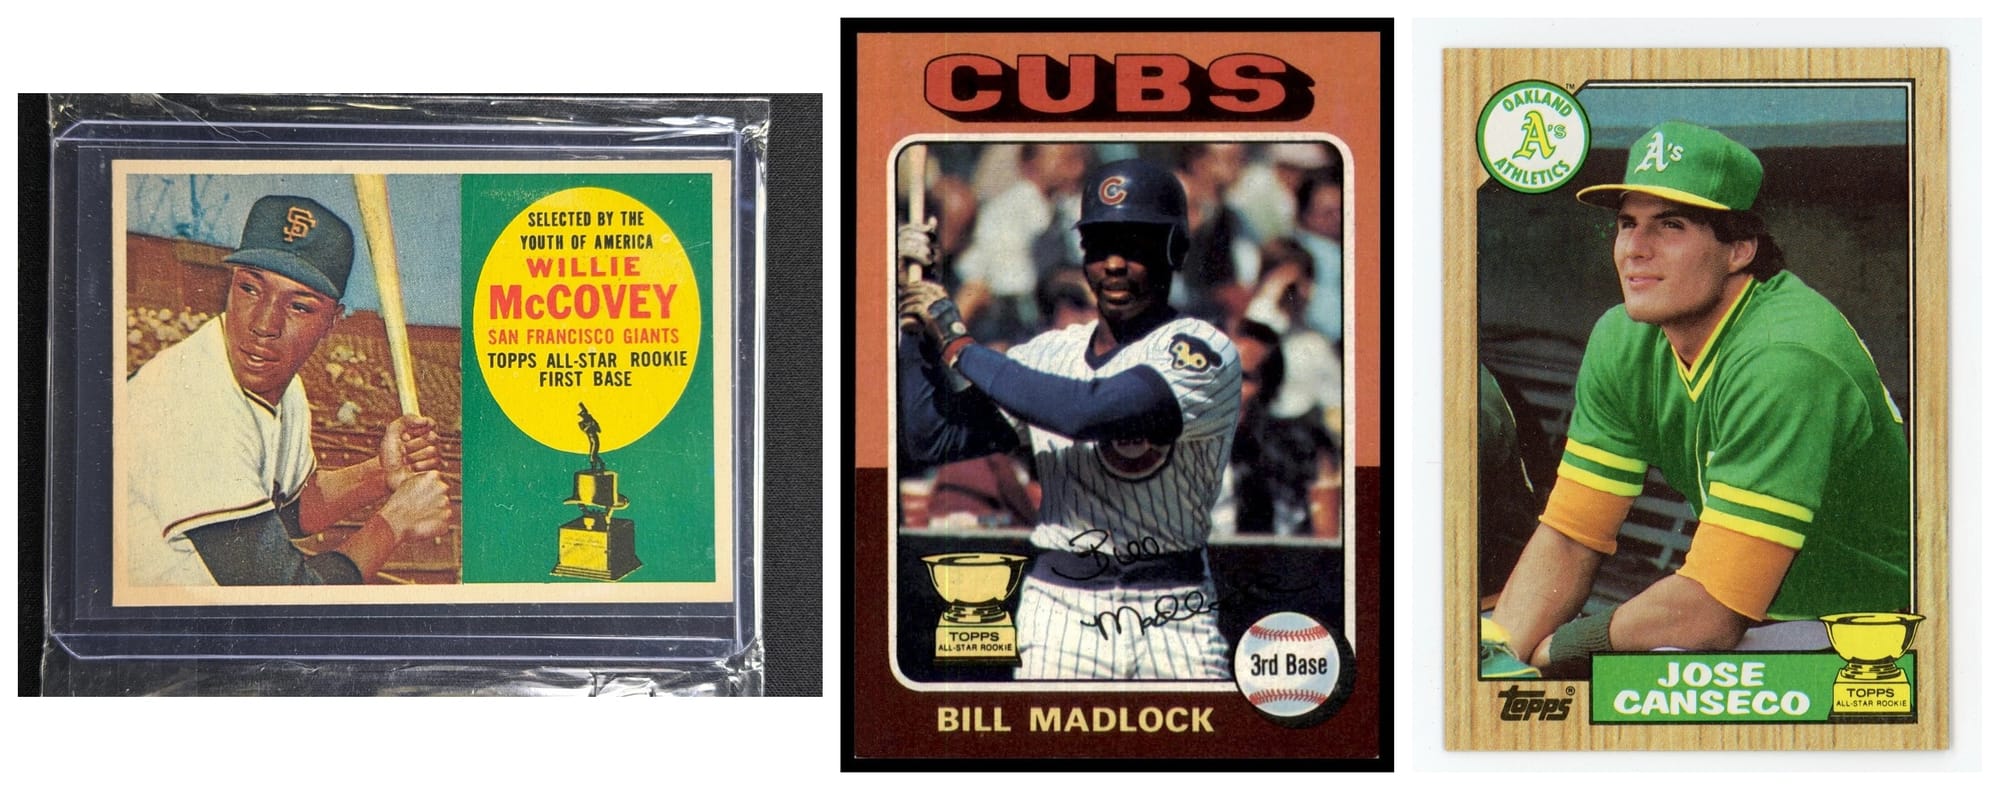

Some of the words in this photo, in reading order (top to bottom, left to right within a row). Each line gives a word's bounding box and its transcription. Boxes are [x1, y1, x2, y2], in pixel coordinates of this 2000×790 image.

[924, 53, 1295, 116] CUBS
[1502, 89, 1573, 118] OAKLAND
[1494, 156, 1571, 186] ATHLETICS
[1100, 175, 1128, 206] C
[528, 211, 591, 227] SELECTED
[599, 211, 613, 227] BY
[621, 211, 645, 226] THE
[520, 234, 564, 250] YOUTH
[571, 234, 587, 250] OF
[594, 234, 653, 249] AMERICA
[526, 256, 641, 278] WILLIE
[489, 284, 678, 320] McCOVEY
[488, 329, 519, 345] SAN
[526, 328, 614, 345] FRANCISCO
[623, 328, 679, 344] GIANTS
[488, 352, 537, 369] TOPPS
[546, 352, 617, 369] ALL-STAR
[630, 351, 688, 367] ROOKIE
[539, 371, 583, 387] FIRST
[593, 371, 632, 387] BASE
[1052, 529, 1161, 580] Bill
[949, 630, 1000, 642] TOPPS
[938, 643, 978, 652] ALL-STAR
[980, 643, 1013, 652] ROOKIE
[1250, 653, 1278, 676] 3rd
[1286, 653, 1328, 676] Base
[1657, 661, 1765, 688] JOSE
[1613, 690, 1811, 716] CANSECO
[1836, 699, 1874, 707] ALL-STAR
[1876, 699, 1907, 707] ROOKIE
[1845, 687, 1895, 698] TOPPS
[937, 707, 1011, 732] BILL
[1030, 707, 1215, 732] MADLOCK
